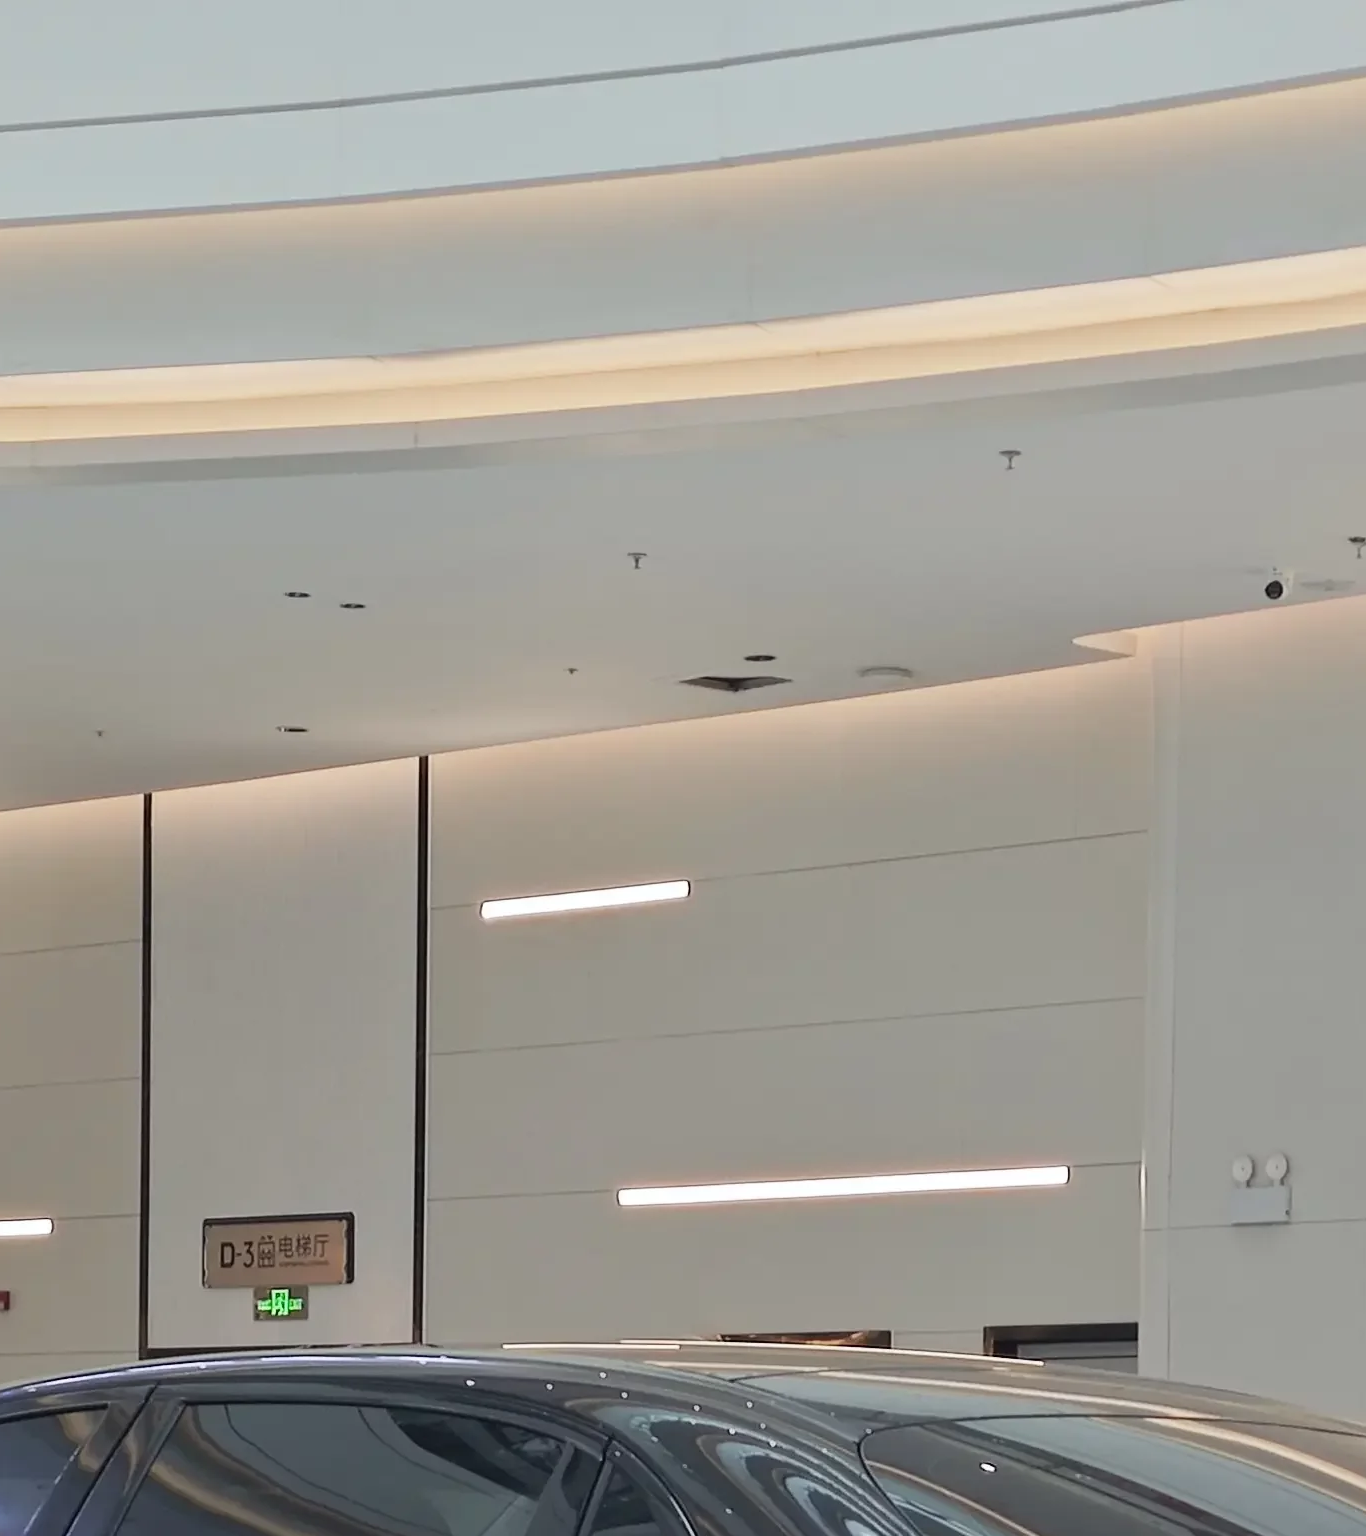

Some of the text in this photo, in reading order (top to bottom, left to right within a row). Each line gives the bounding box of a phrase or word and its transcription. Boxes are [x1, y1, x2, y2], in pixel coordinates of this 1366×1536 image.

[220, 1234, 330, 1269] D-3 电梯厅
